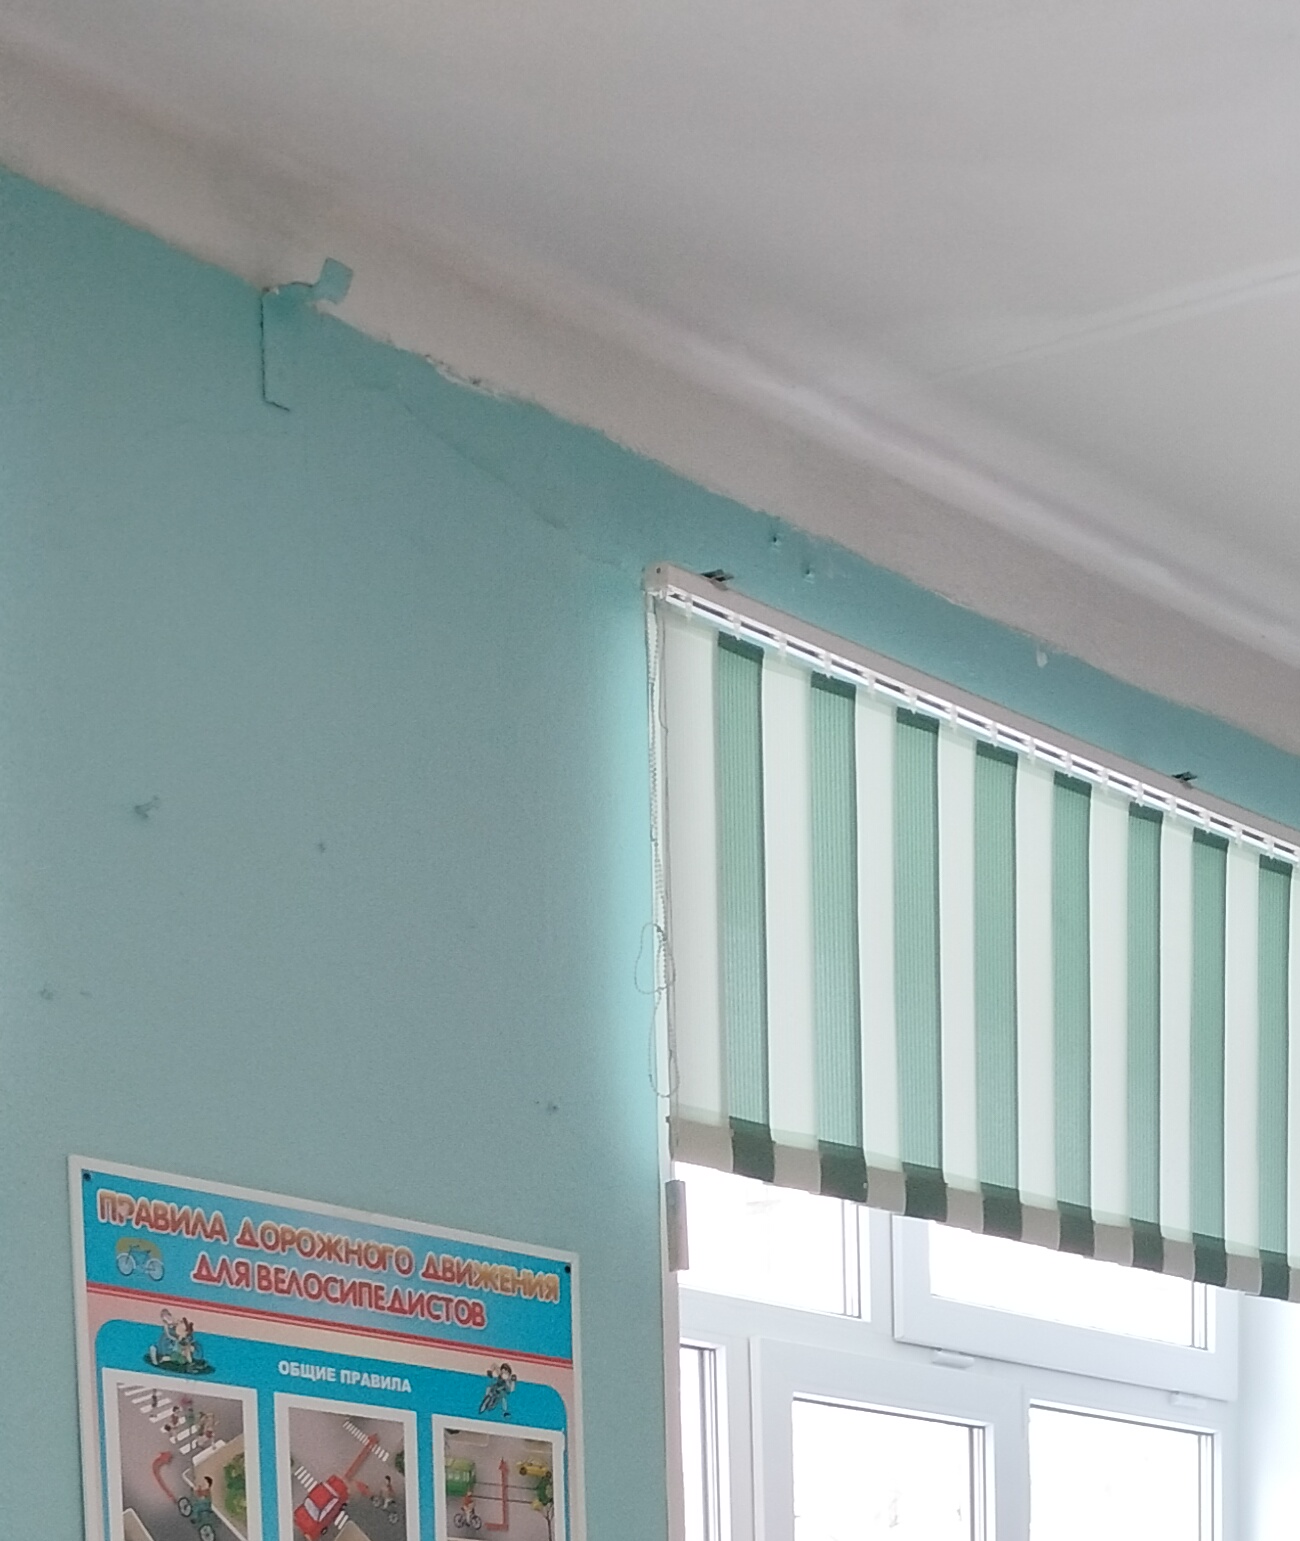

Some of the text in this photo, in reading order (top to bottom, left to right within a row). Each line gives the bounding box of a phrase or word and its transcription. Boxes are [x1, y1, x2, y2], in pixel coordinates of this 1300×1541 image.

[98, 1189, 560, 1303] ПРАВИЛА ДОРОЖНОГО ДВИЖЕНИЯ
[192, 1253, 486, 1328] ДЛЯ ВЕЛОСИПЕДИСТОВ
[278, 1359, 412, 1393] ОБЩИЕ ПРАВИЛА
